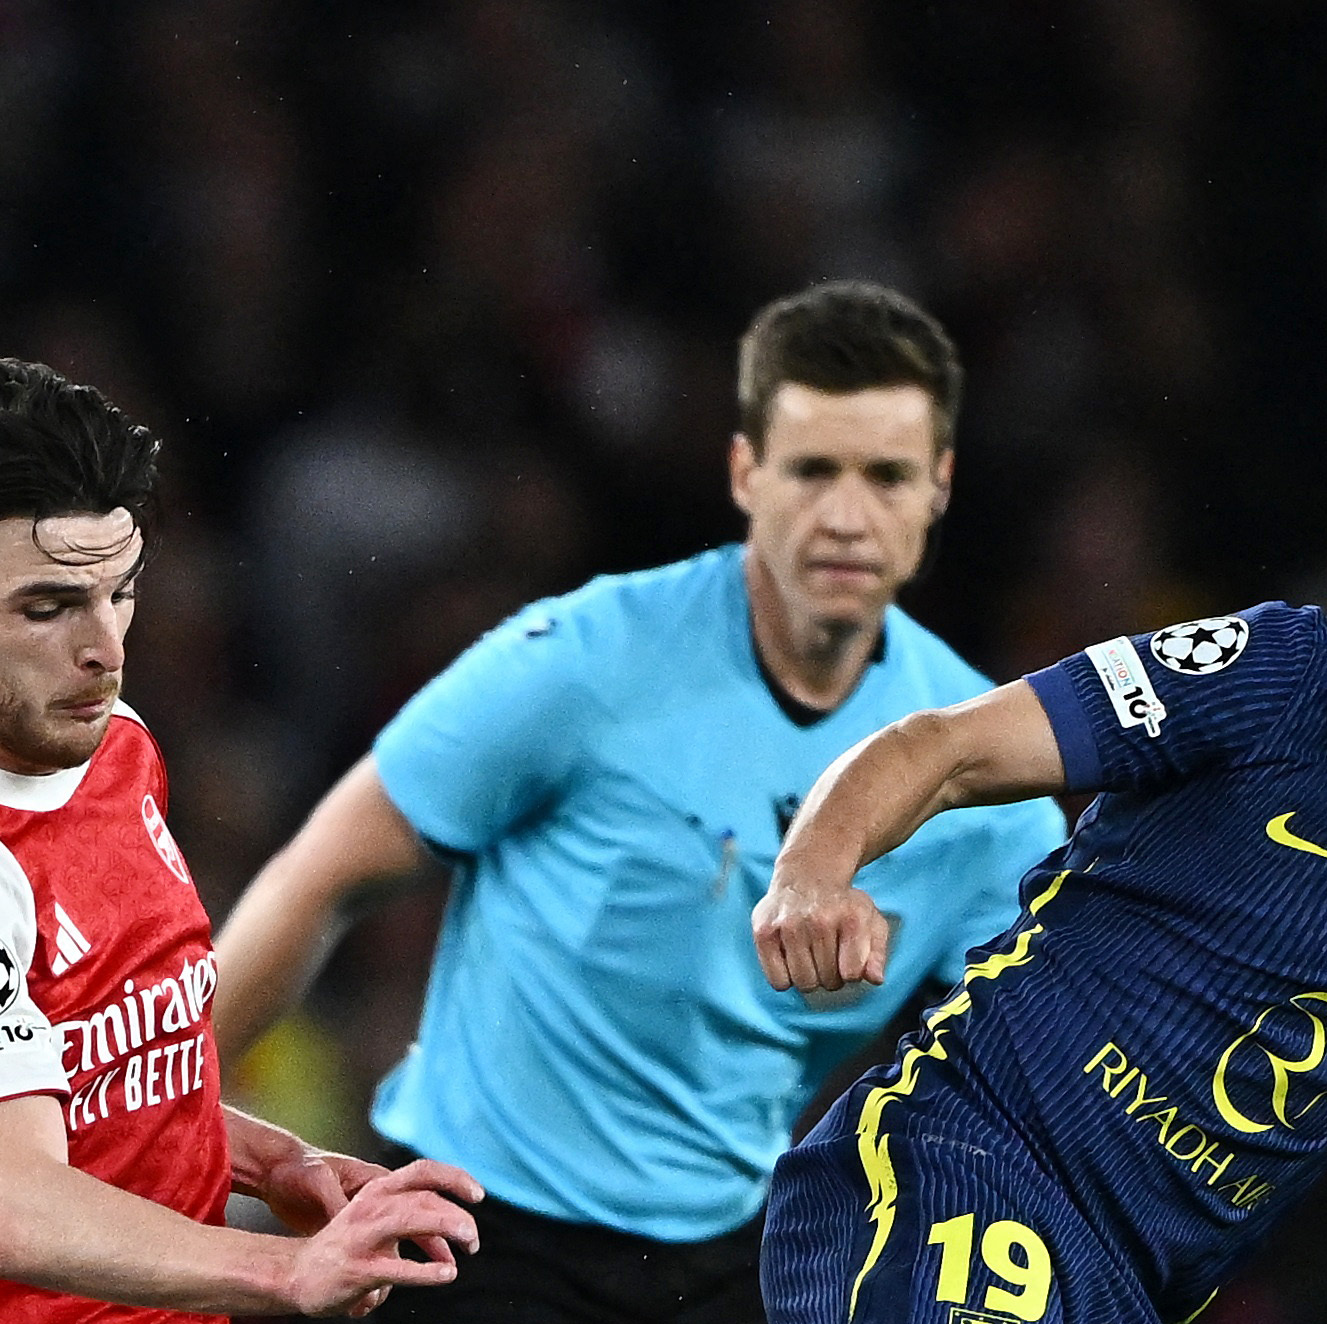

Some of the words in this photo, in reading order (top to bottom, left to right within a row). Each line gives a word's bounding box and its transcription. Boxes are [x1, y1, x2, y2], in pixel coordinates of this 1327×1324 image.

[58, 950, 218, 1079] Emirates
[70, 1067, 121, 1131] FLY
[124, 1032, 204, 1112] BETTE
[1083, 1042, 1235, 1186] RIYADH
[927, 1212, 1053, 1322] 19
